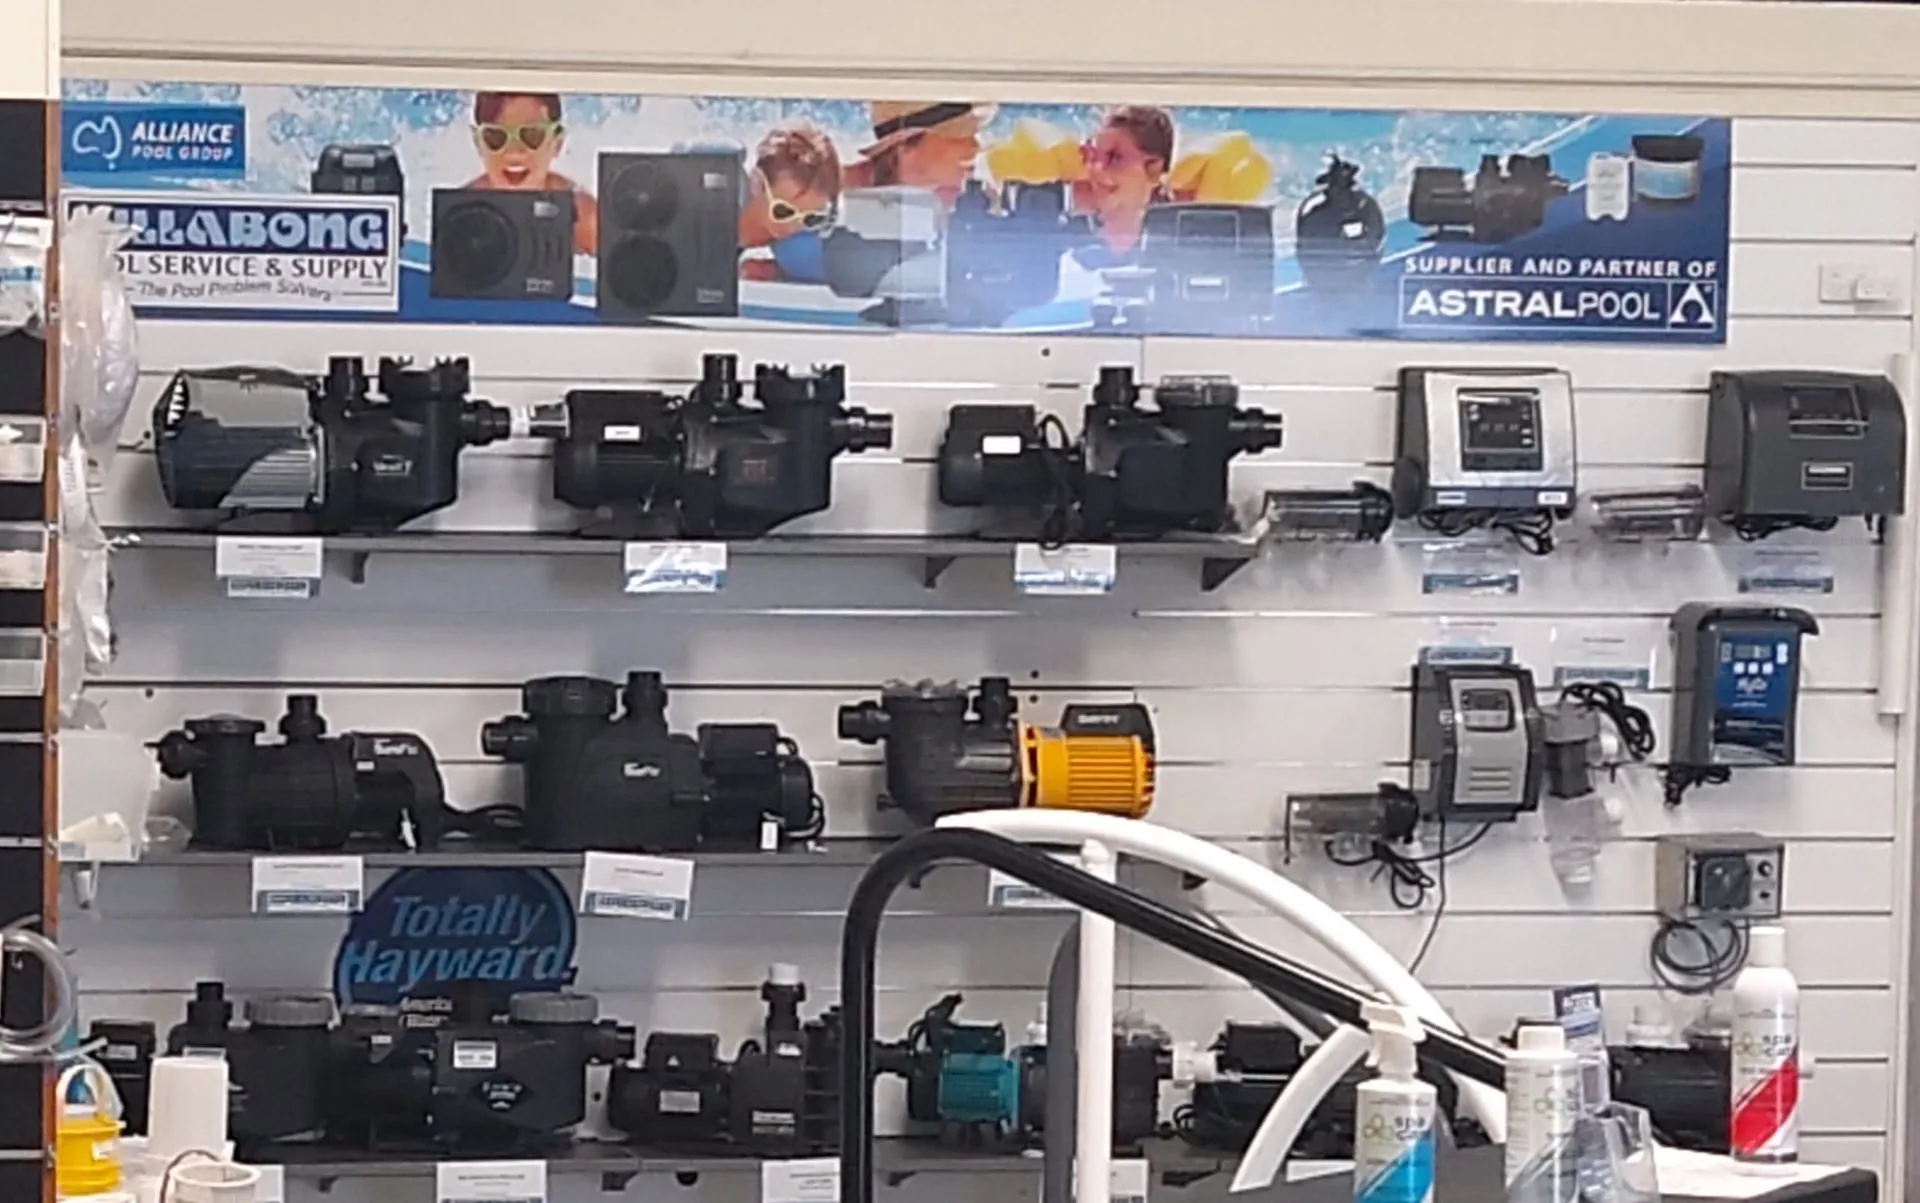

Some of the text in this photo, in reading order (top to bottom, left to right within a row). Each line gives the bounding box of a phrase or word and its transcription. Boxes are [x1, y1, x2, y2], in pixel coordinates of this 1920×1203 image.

[131, 121, 235, 144] ALLIANCE
[131, 144, 234, 161] POOL GROUP
[148, 254, 256, 277] SERVICE
[264, 257, 283, 277] &
[291, 258, 388, 279] SUPPLY
[1405, 257, 1717, 278] SUPPLIER AND PARTNER OF
[138, 281, 167, 296] The
[171, 282, 205, 299] Pool
[207, 280, 271, 297] Problem
[1408, 289, 1660, 320] ASTRALPOOL
[390, 894, 547, 945] Totally
